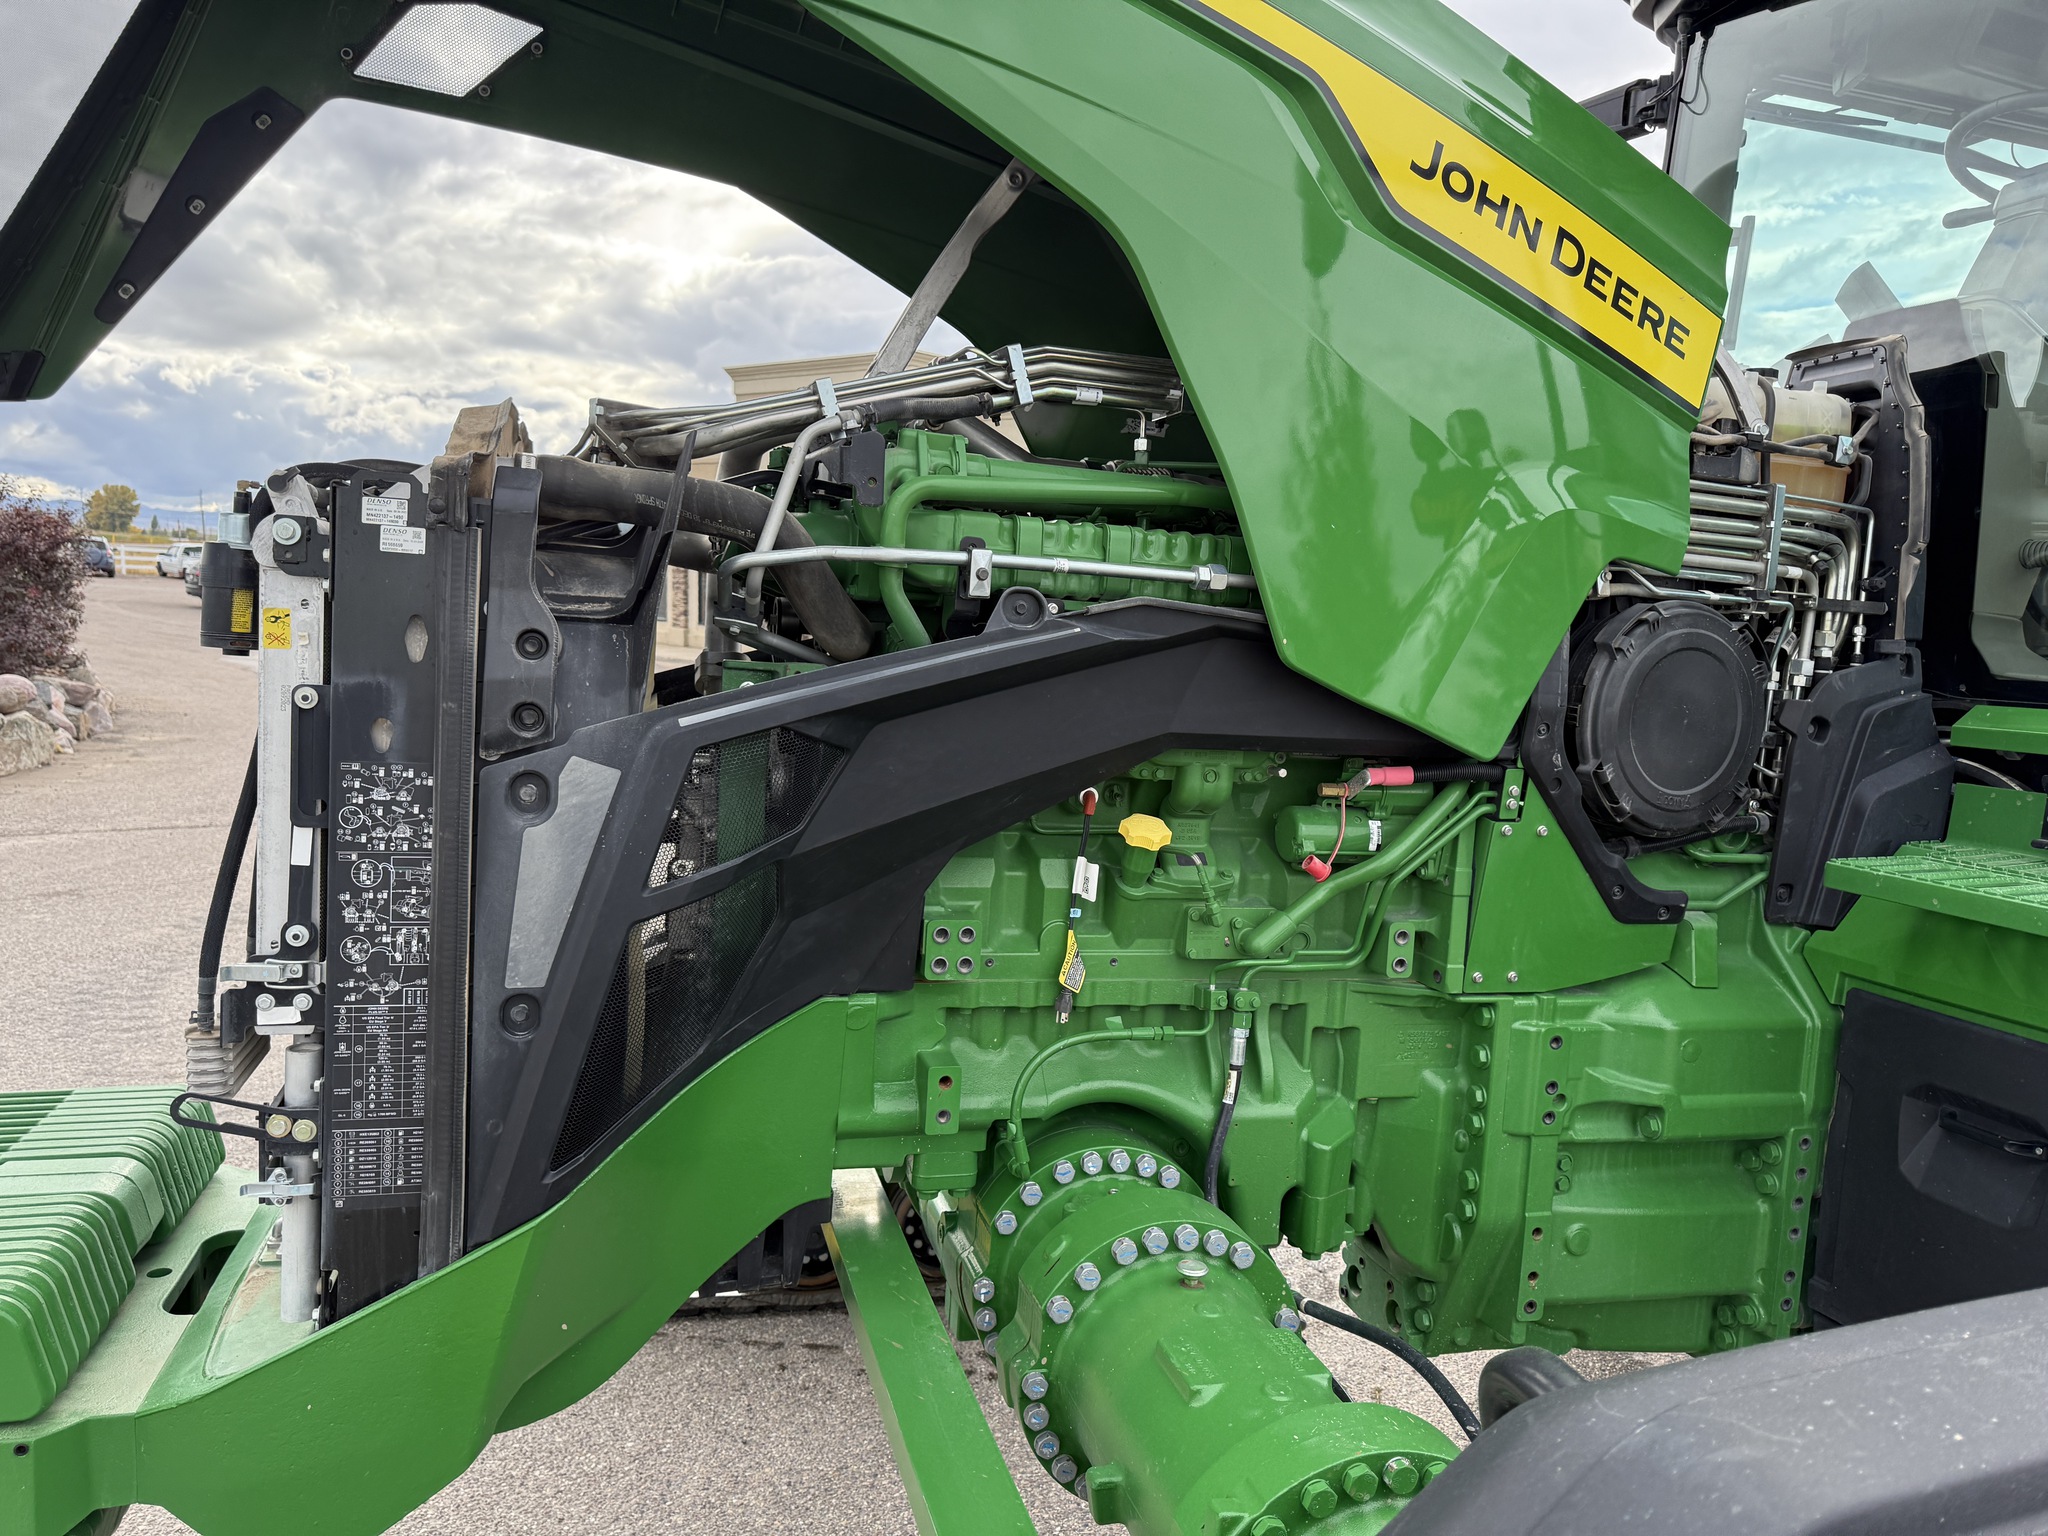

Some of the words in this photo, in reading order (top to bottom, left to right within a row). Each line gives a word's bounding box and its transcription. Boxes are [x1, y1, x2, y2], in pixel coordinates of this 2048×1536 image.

[1409, 140, 1543, 254] JOHN
[1550, 225, 1690, 360] DEERE
[1063, 941, 1077, 969] CAUTION
